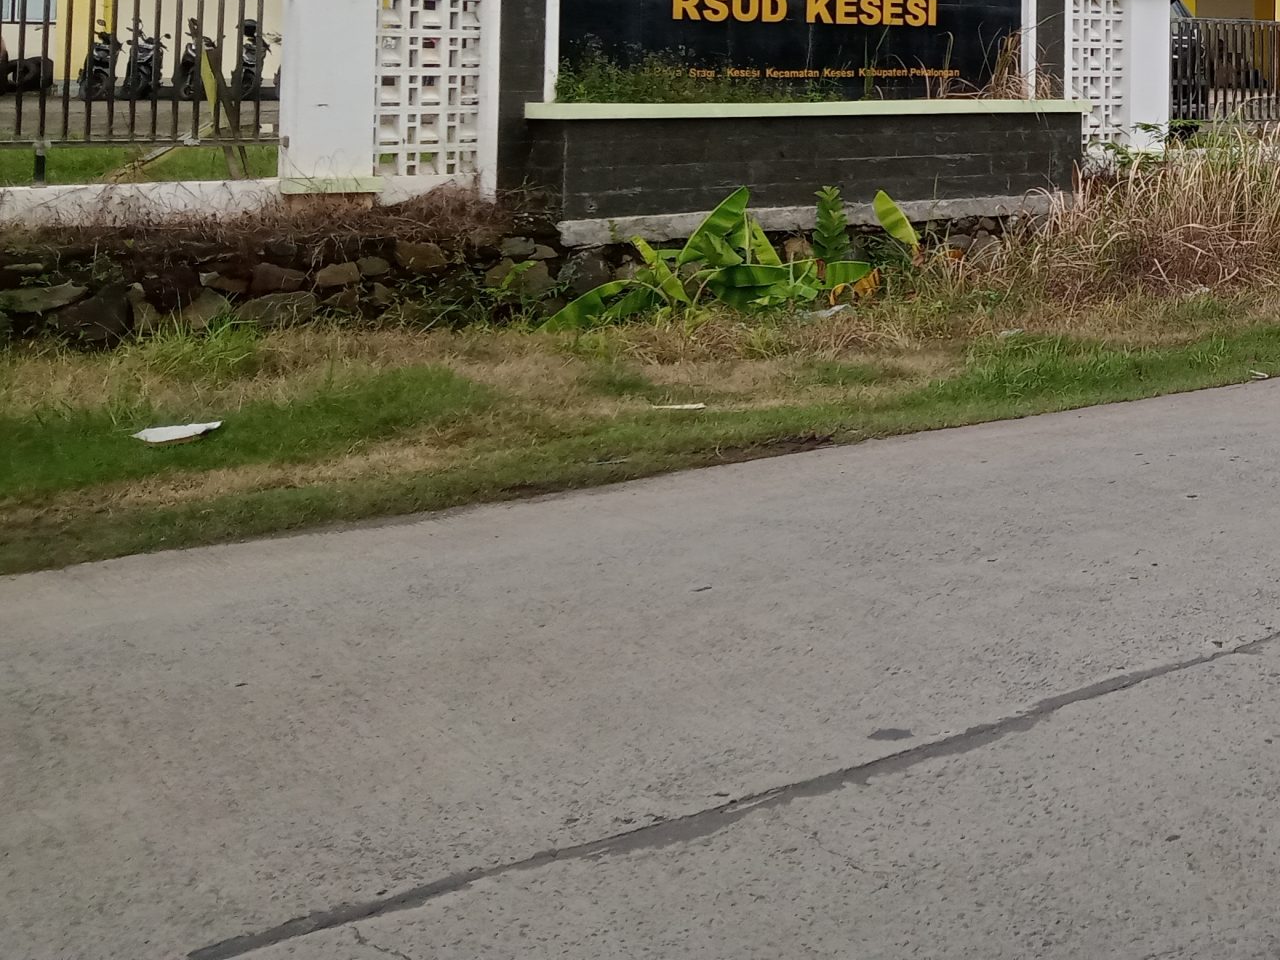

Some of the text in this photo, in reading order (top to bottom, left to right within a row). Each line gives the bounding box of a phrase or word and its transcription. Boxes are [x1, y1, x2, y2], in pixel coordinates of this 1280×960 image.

[689, 68, 715, 80] Sragi
[766, 68, 819, 78] Kecamatan
[824, 68, 855, 78] Kesesi
